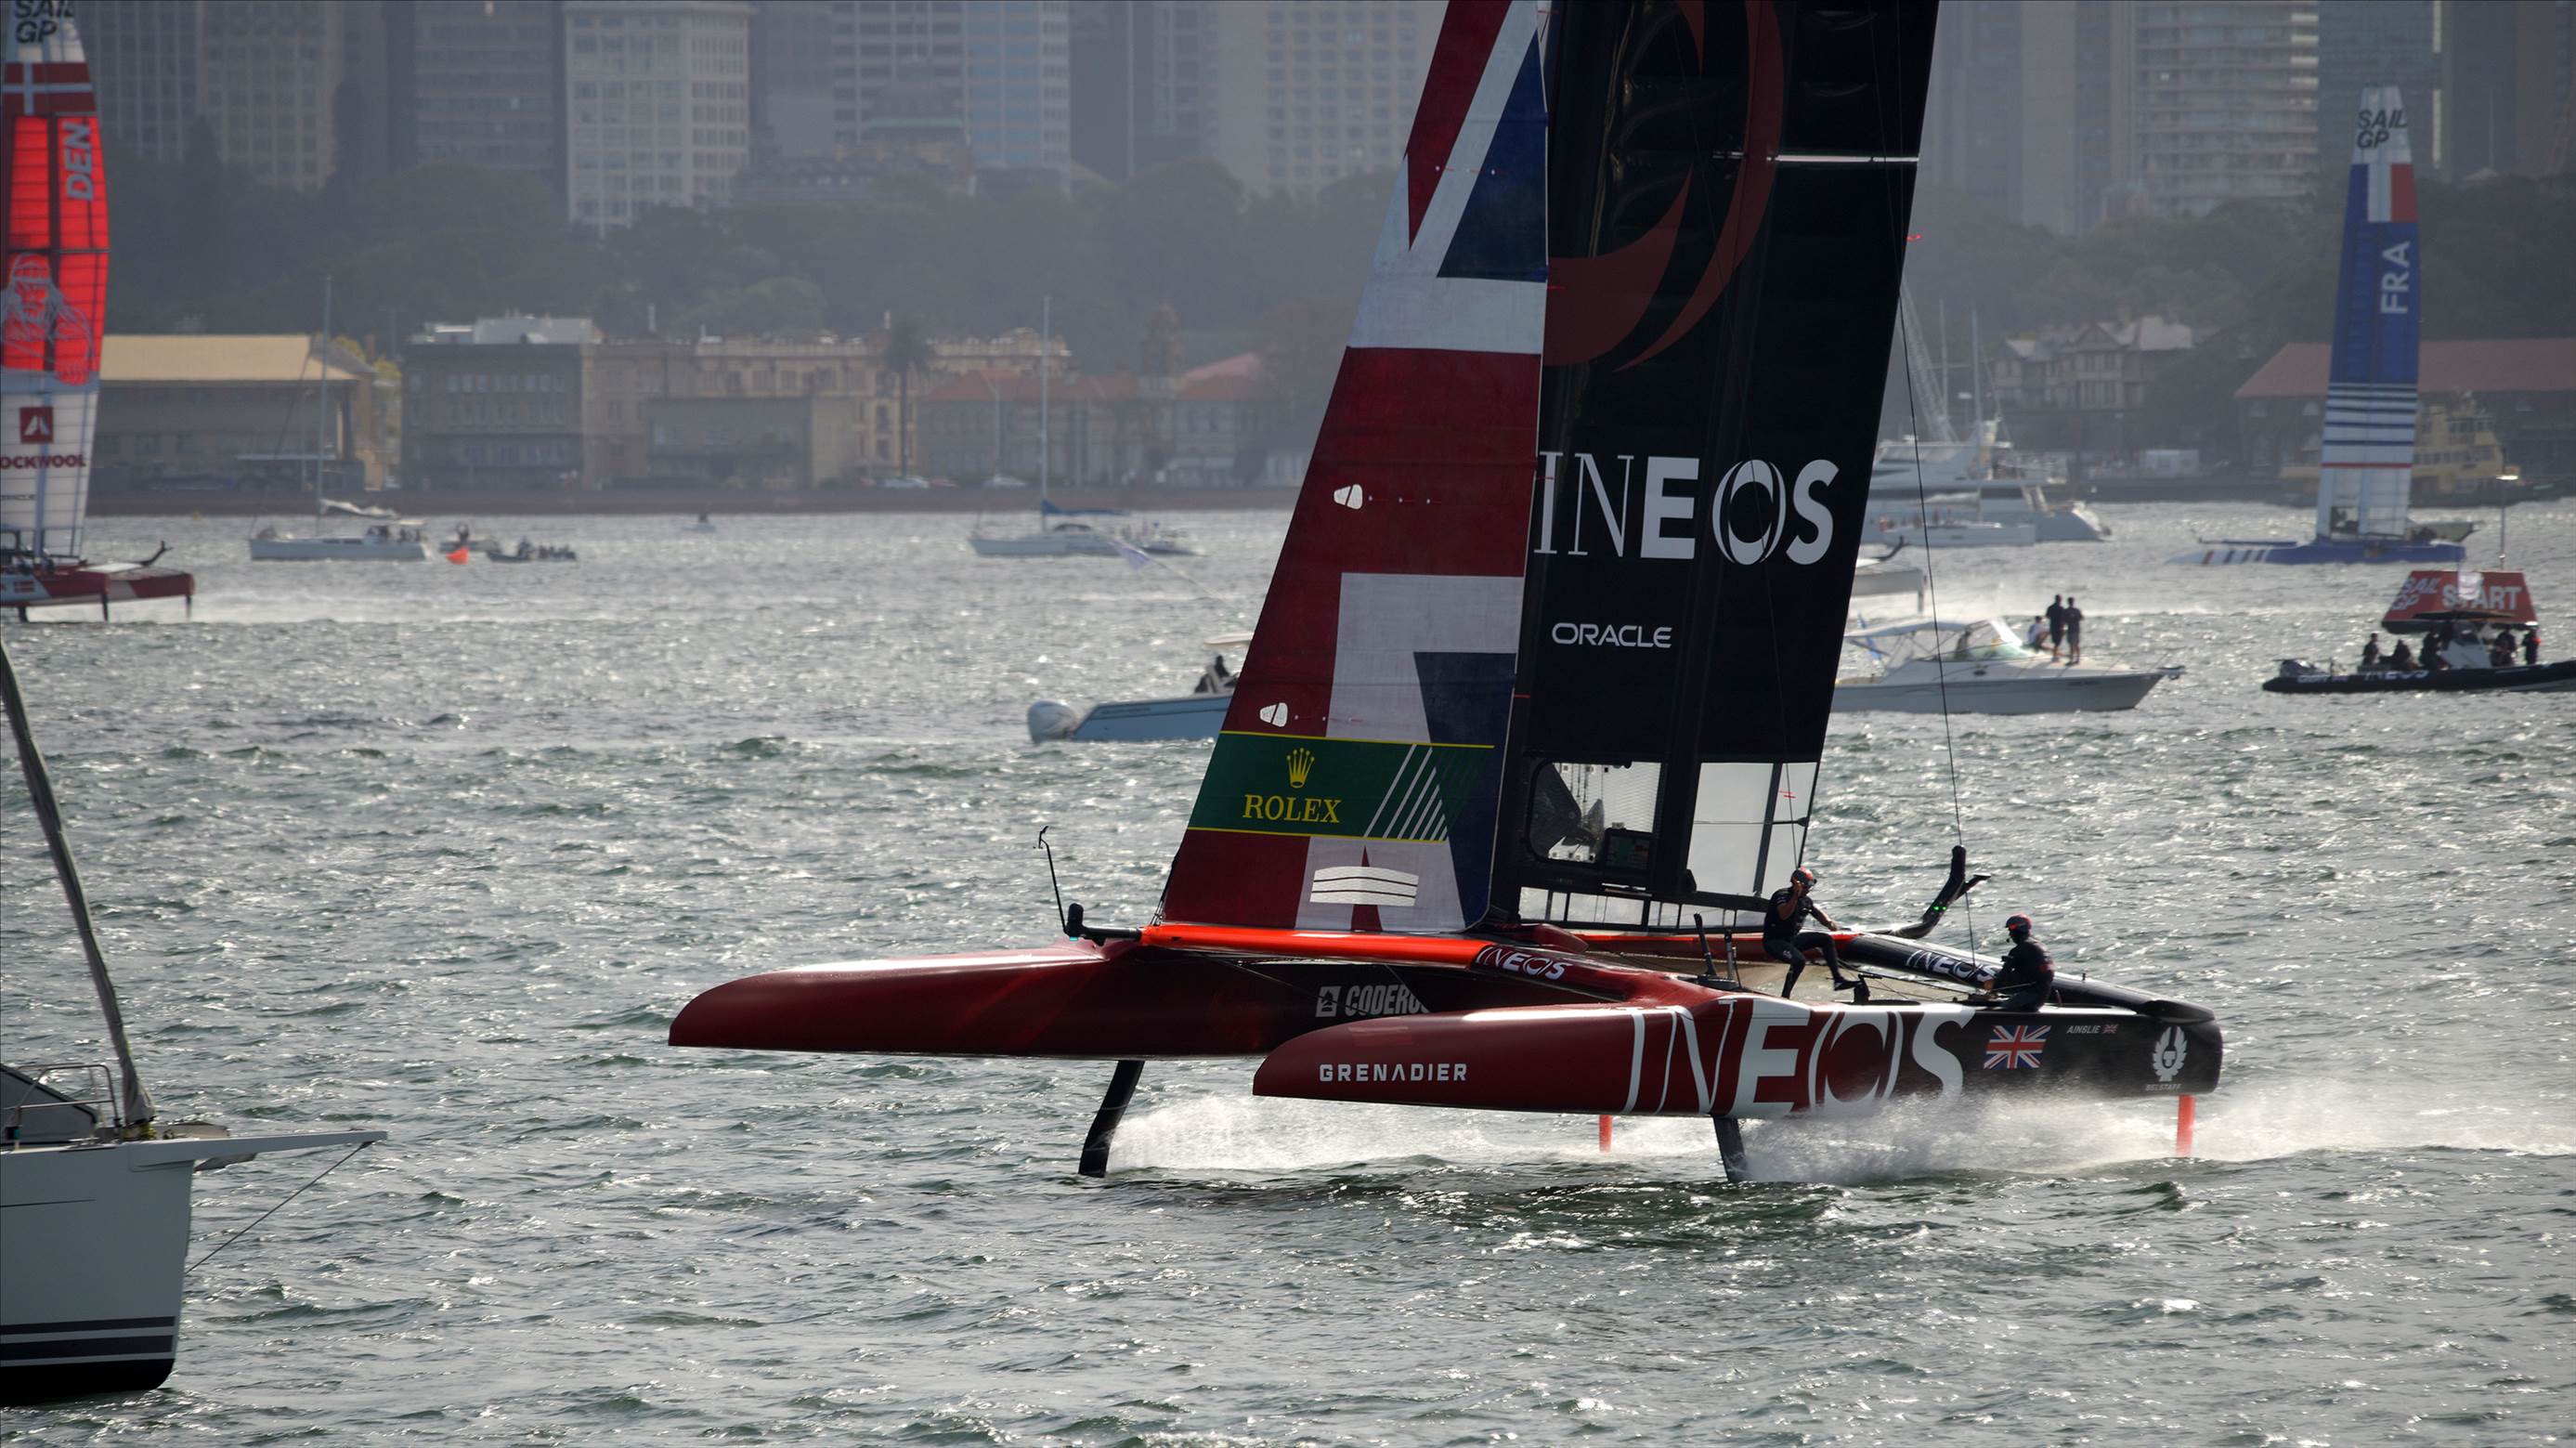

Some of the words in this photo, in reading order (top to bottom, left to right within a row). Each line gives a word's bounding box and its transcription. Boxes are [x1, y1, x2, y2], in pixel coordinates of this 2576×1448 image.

[16, 20, 58, 44] GP
[2358, 109, 2408, 129] SAIL
[2356, 128, 2390, 150] GP
[62, 120, 93, 202] DEN
[2381, 241, 2411, 315] FRA
[1534, 450, 1840, 566] INEOS
[2441, 584, 2522, 610] SART
[1552, 622, 1672, 648] ORACLE
[1242, 794, 1342, 824] ROLEX
[1476, 946, 1574, 981] INEOS
[1906, 949, 1997, 983] INEOS
[2066, 1024, 2101, 1034] AINSLIE
[1620, 994, 1976, 1116] INEOS
[1319, 1062, 1467, 1082] GRENADIER
